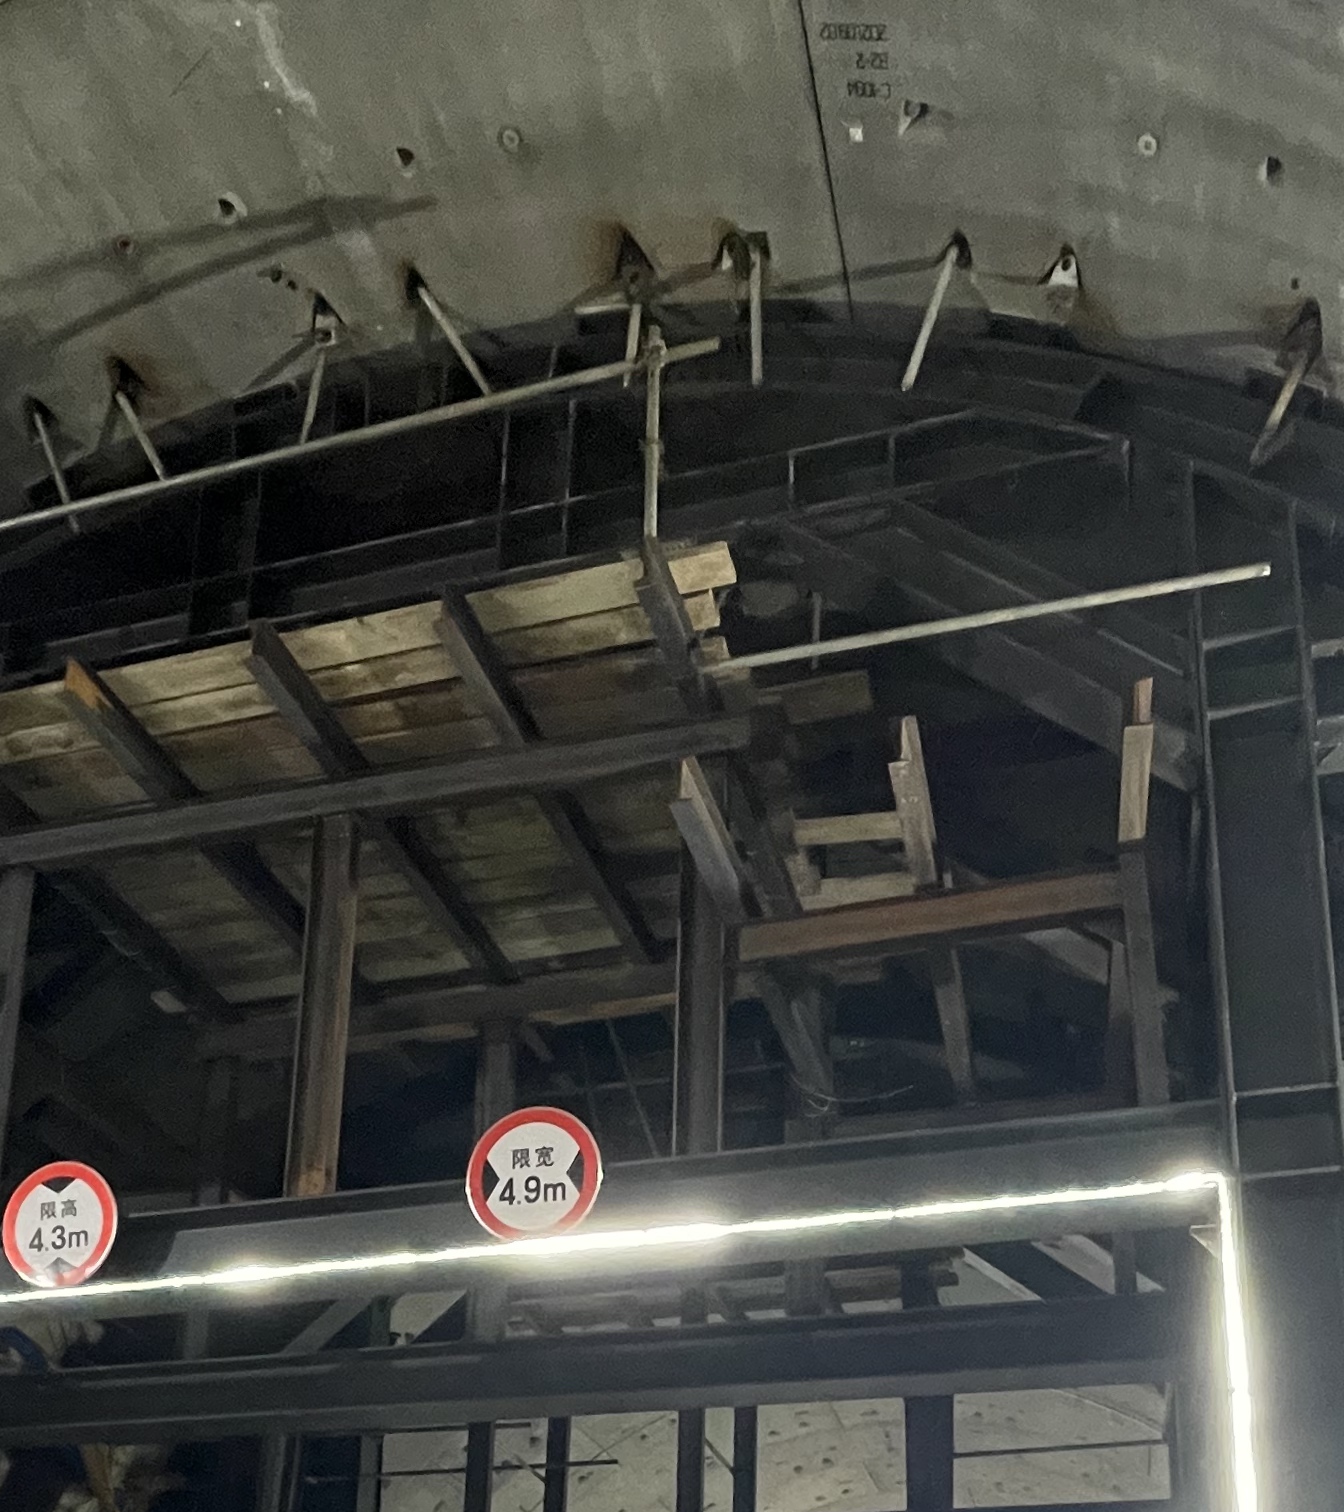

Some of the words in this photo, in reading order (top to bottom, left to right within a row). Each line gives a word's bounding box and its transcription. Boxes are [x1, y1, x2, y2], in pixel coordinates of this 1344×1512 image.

[511, 1146, 555, 1171] 限宽
[498, 1175, 567, 1207] 4.9m
[39, 1200, 78, 1221] 限高
[28, 1225, 90, 1253] 4.3m
